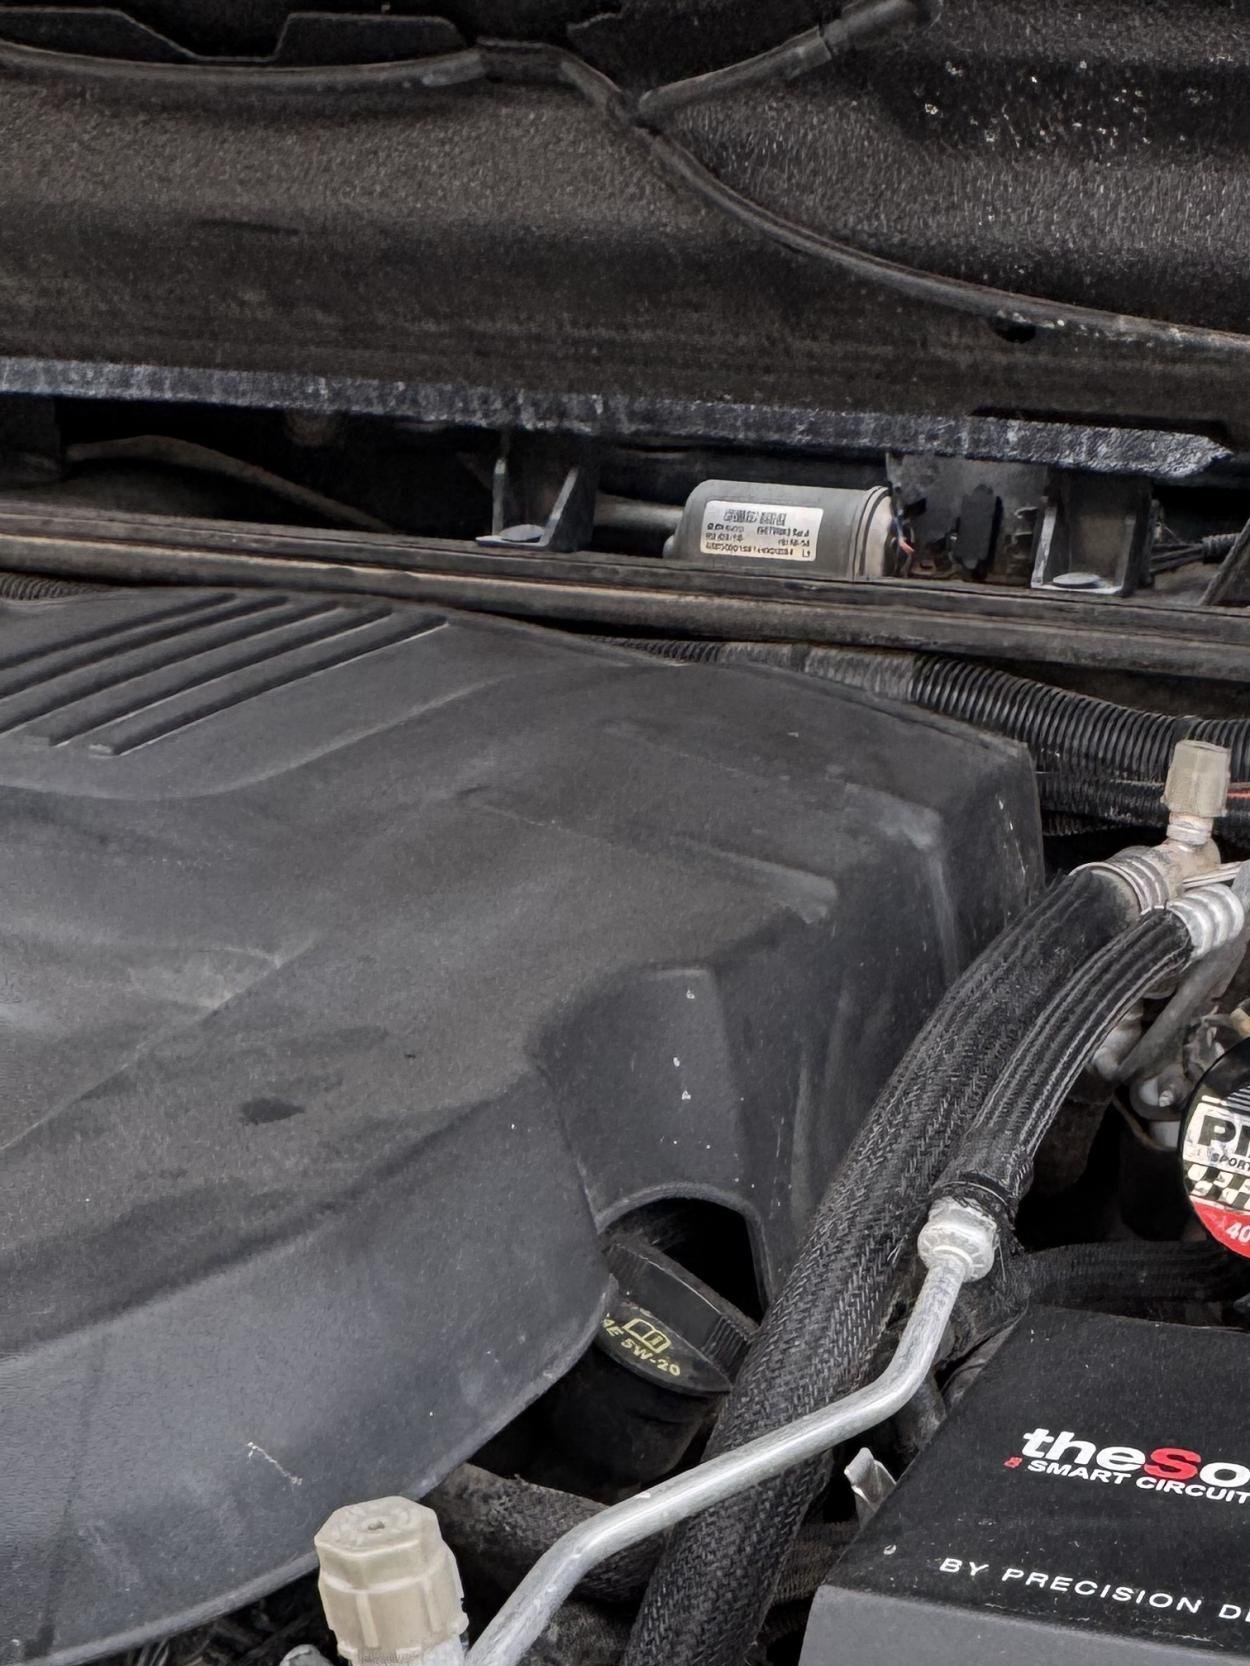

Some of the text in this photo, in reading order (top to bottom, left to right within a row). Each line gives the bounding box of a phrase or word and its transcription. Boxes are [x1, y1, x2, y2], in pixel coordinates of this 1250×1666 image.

[603, 1312, 680, 1376] AE 5W-20
[1027, 1460, 1132, 1485] SMART
[939, 1557, 990, 1577] BY
[1001, 1568, 1202, 1614] PRECISION
